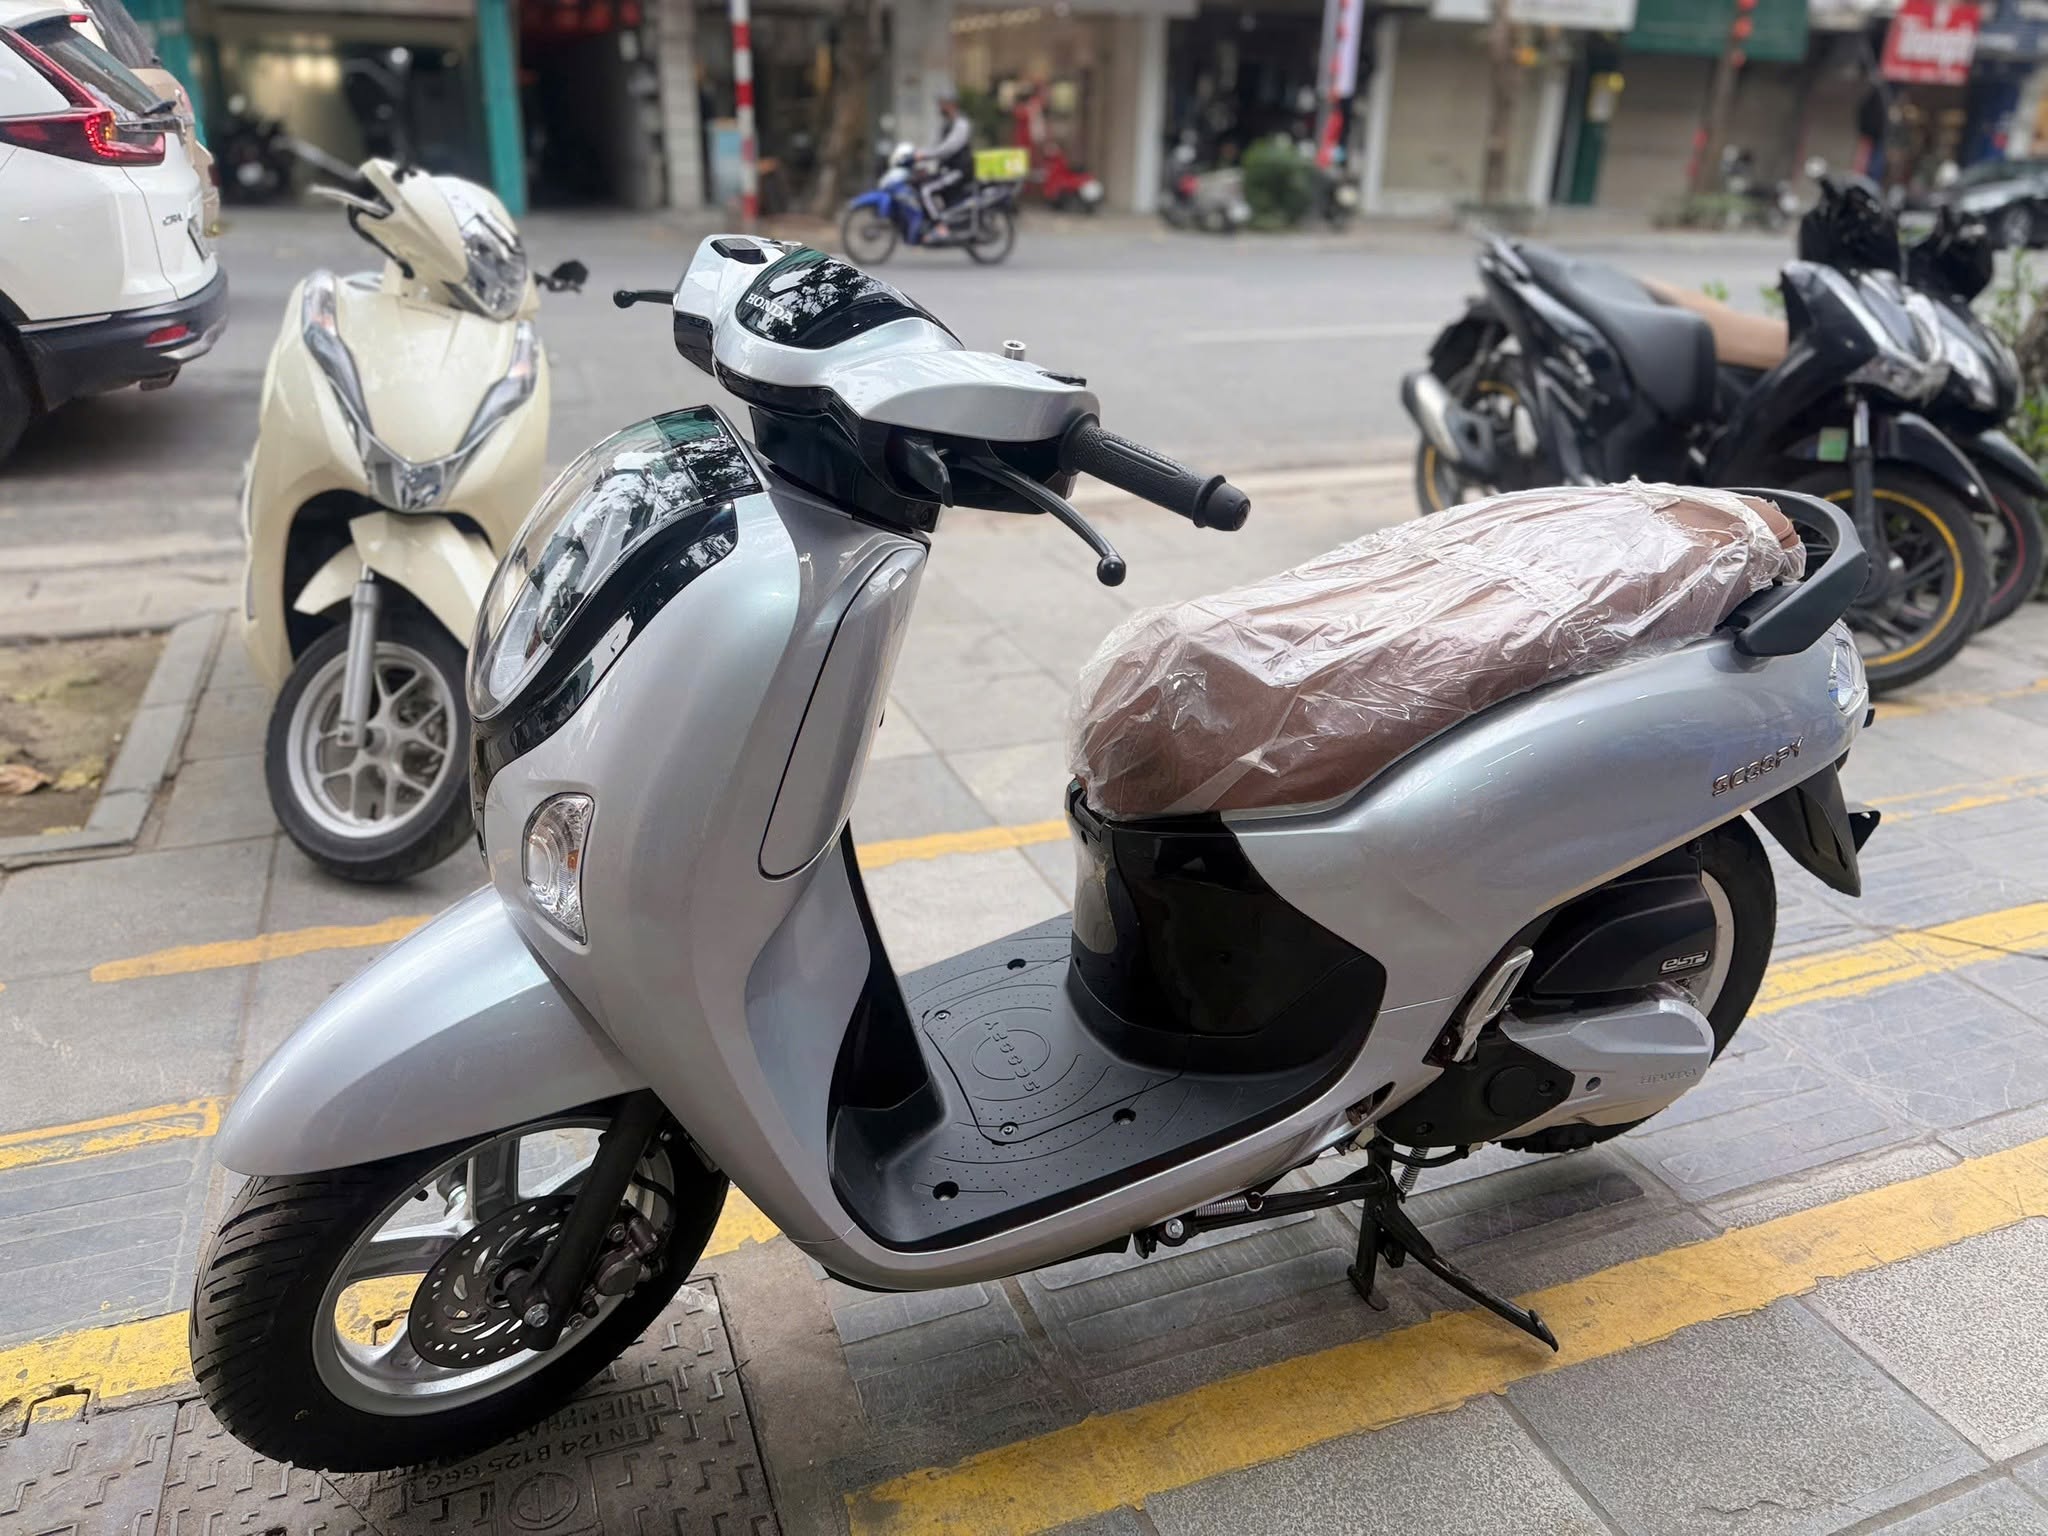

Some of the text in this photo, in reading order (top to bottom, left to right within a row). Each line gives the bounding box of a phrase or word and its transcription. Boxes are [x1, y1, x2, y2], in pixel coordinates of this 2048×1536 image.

[745, 292, 793, 326] HONDA
[1711, 736, 1804, 797] SCOOPY
[560, 1431, 601, 1455] 124
[487, 1446, 550, 1473] B125
